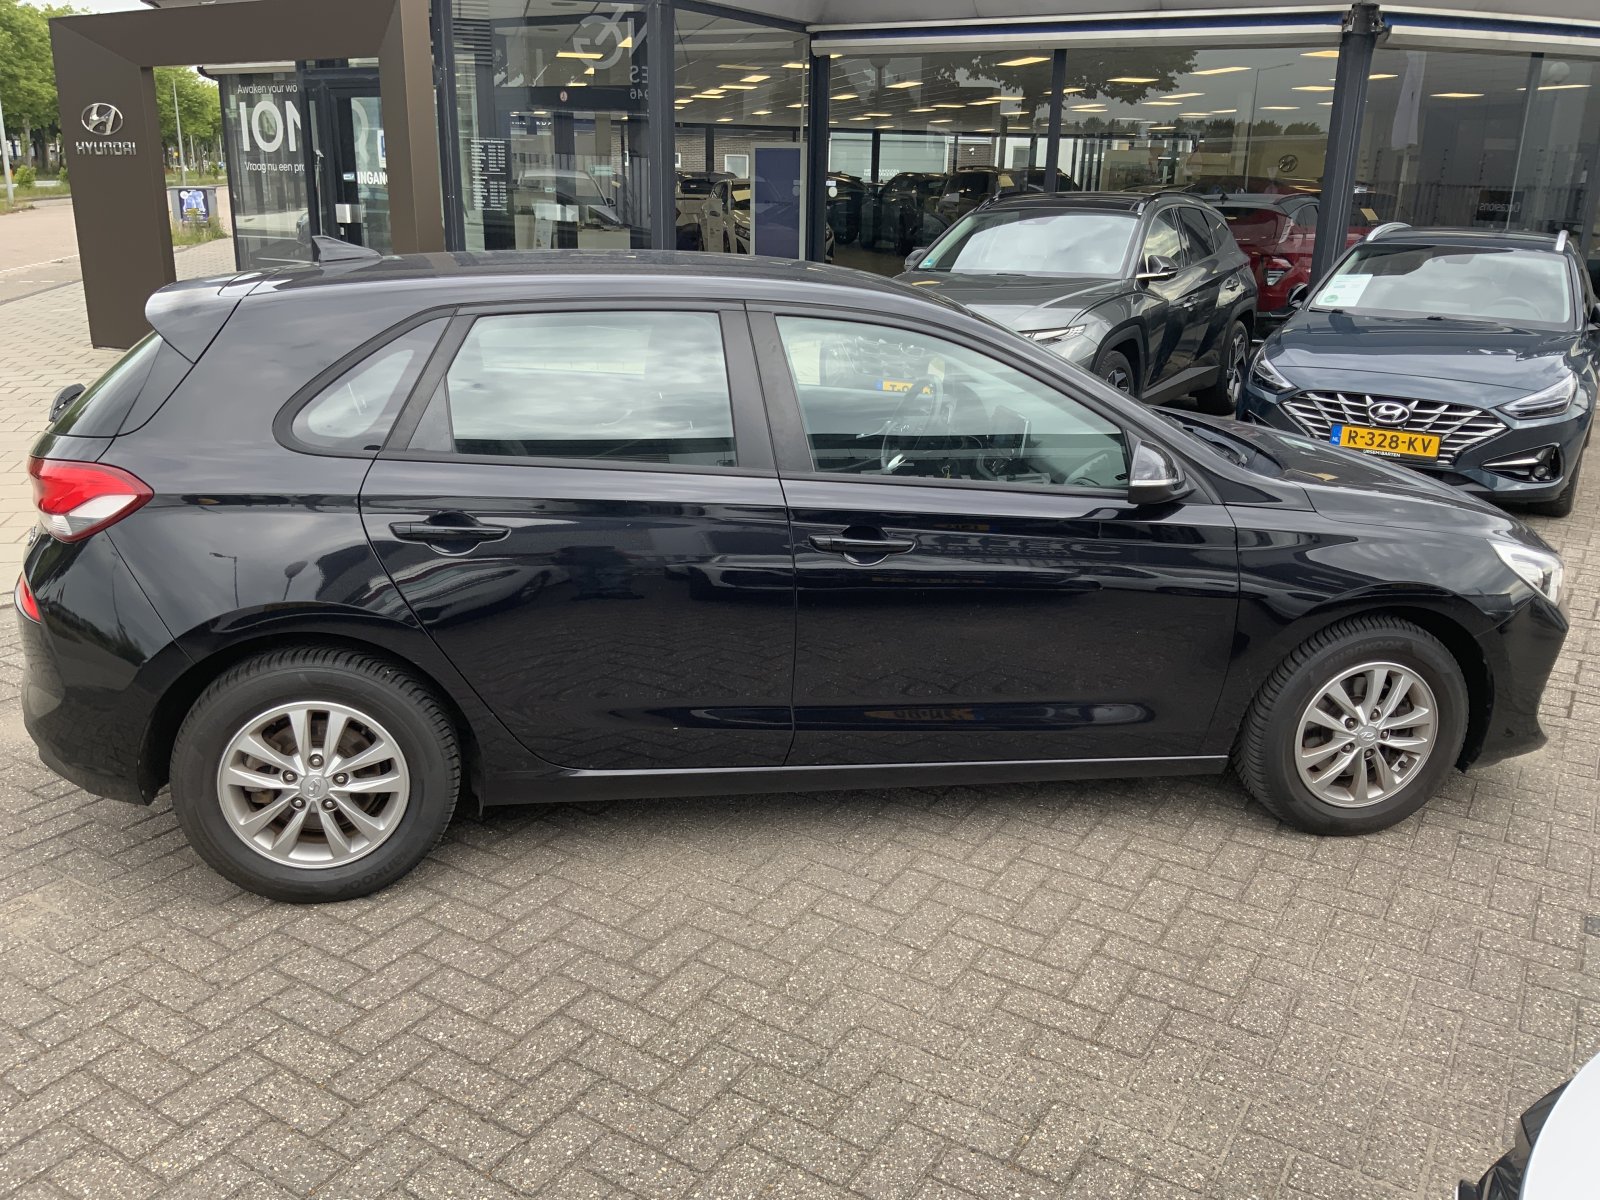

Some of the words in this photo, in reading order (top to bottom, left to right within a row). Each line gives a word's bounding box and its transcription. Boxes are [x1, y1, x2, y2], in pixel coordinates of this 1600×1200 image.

[237, 84, 266, 94] Awaken
[267, 84, 284, 95] your
[75, 141, 137, 156] HYUNDAI
[245, 161, 267, 174] Vraag
[268, 162, 278, 171] nu
[278, 163, 293, 172] een
[357, 171, 388, 185] INGAN
[1347, 429, 1433, 453] R-328-KV
